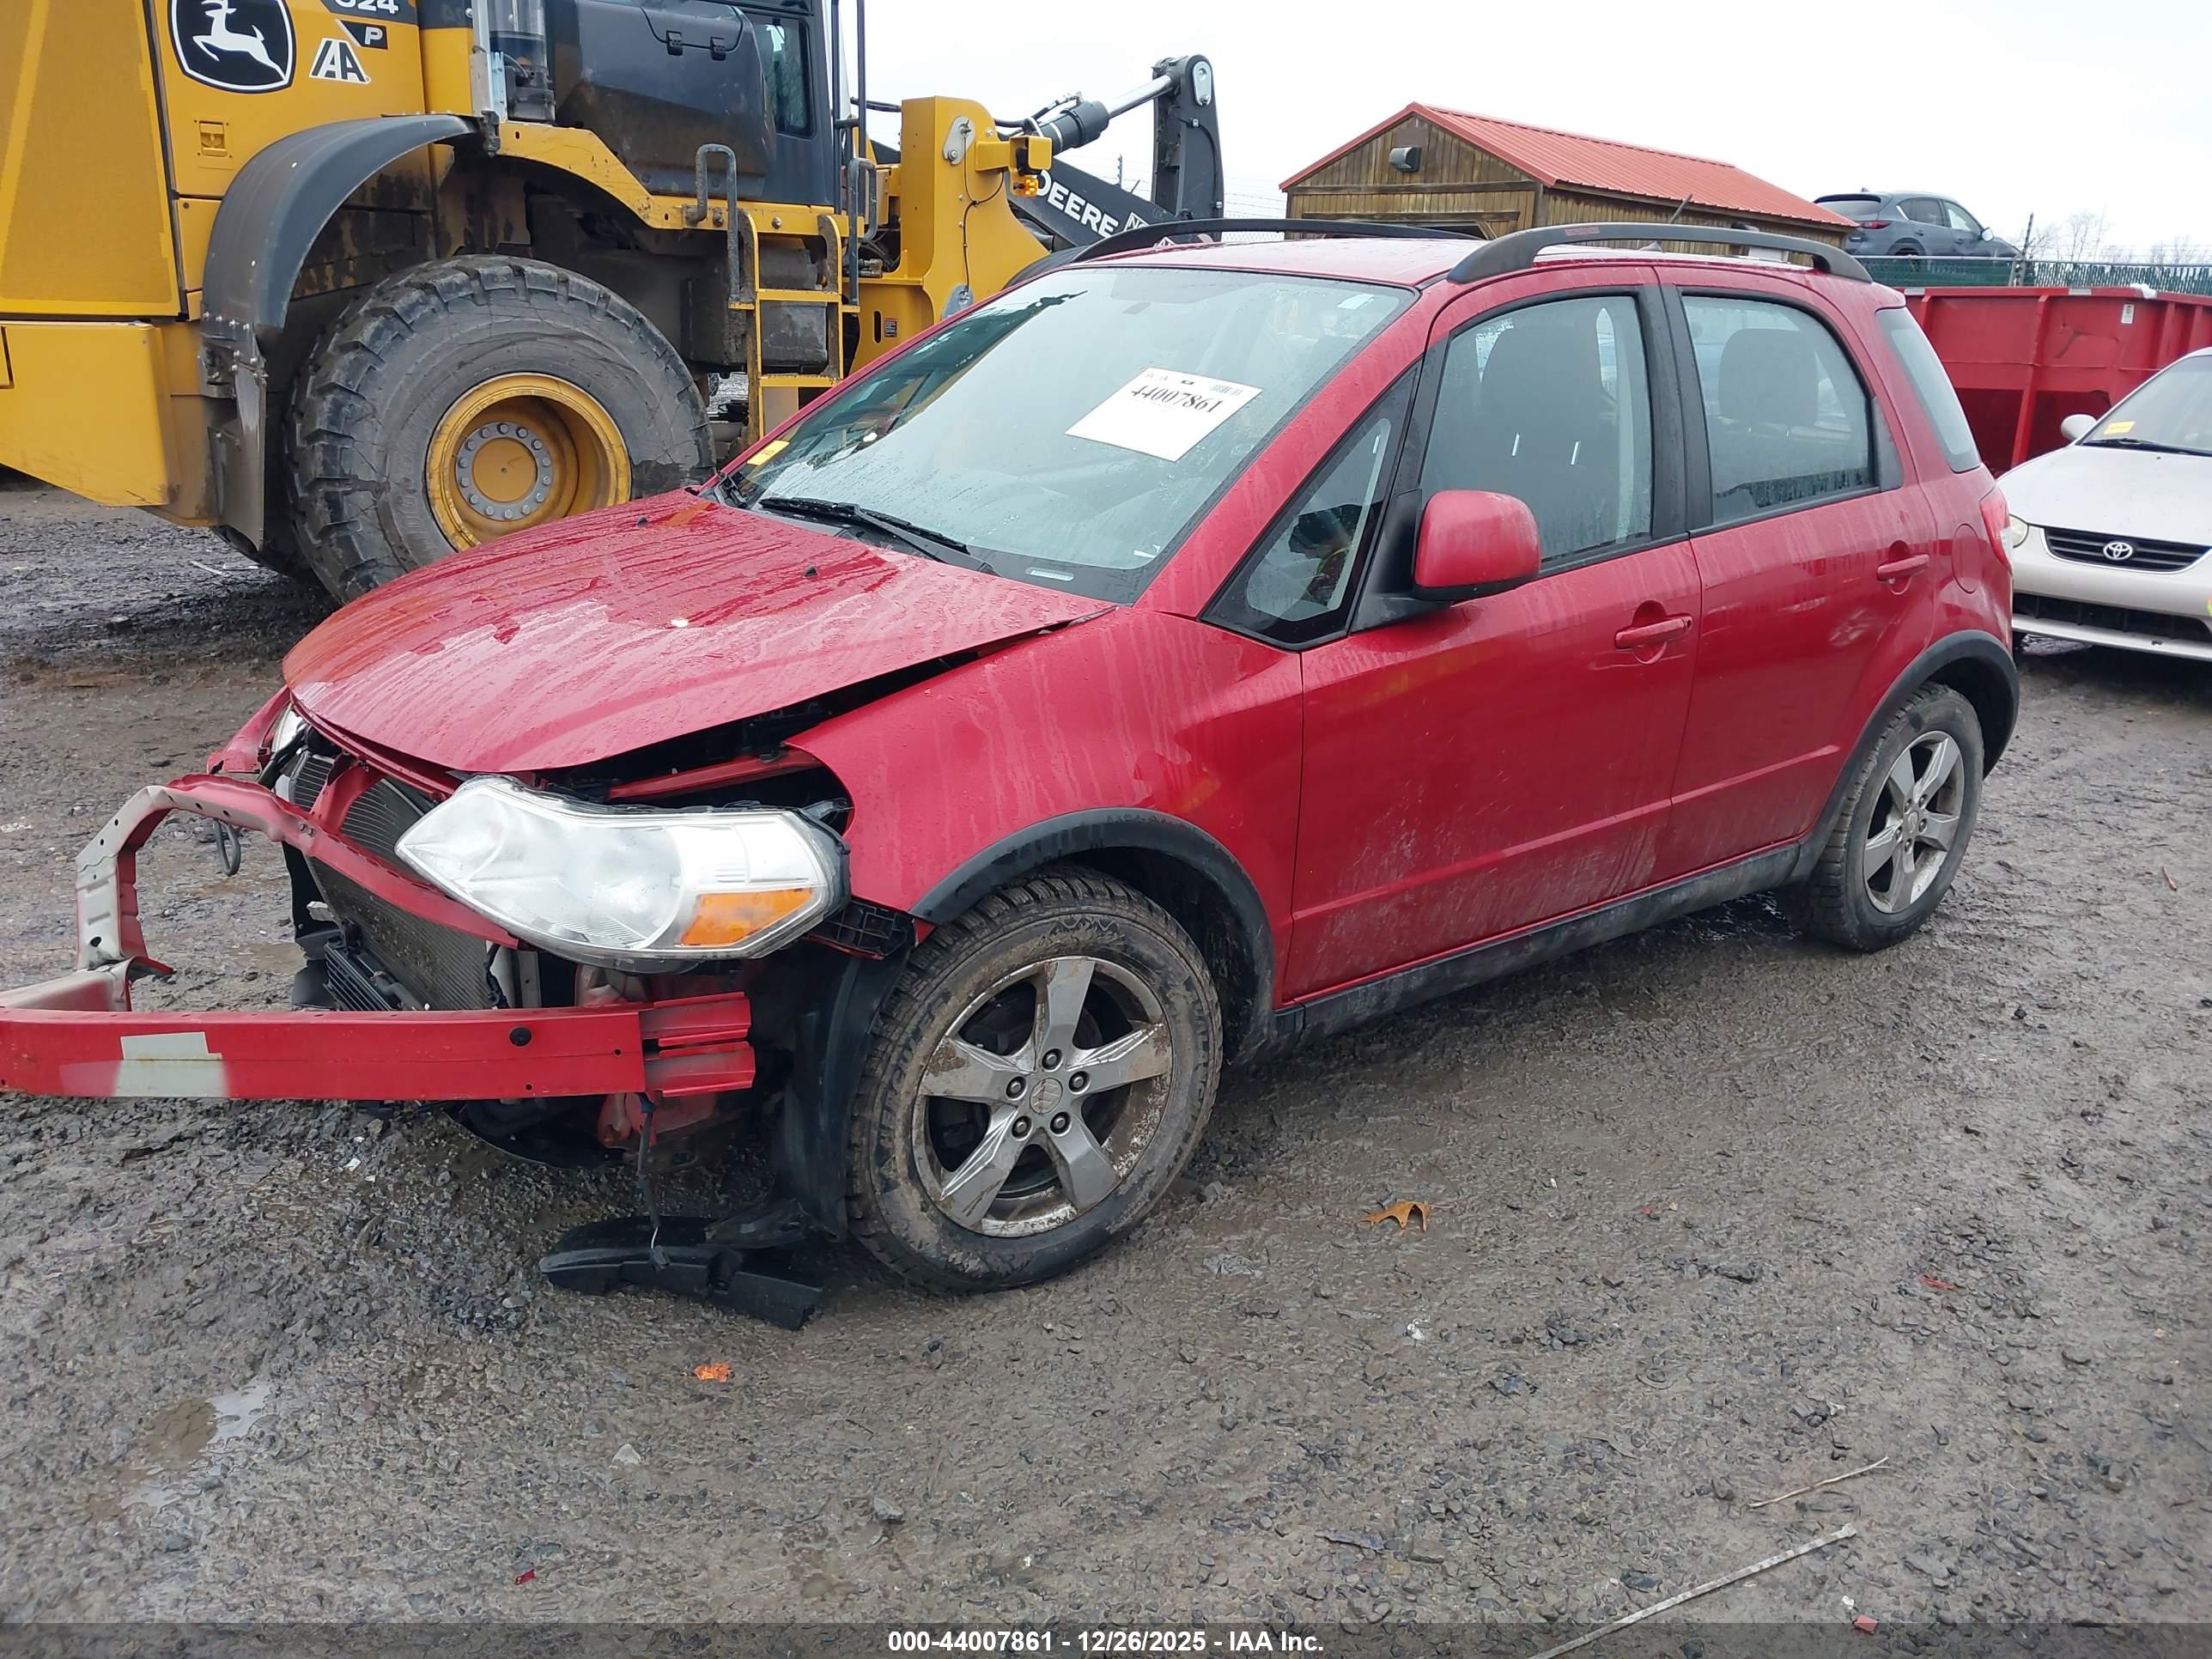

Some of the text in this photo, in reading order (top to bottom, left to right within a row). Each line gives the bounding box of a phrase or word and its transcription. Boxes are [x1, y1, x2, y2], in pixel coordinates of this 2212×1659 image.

[364, 26, 383, 45] P
[310, 40, 367, 82] IAA
[1036, 169, 1119, 238] DEERE
[1131, 385, 1224, 413] 44007861
